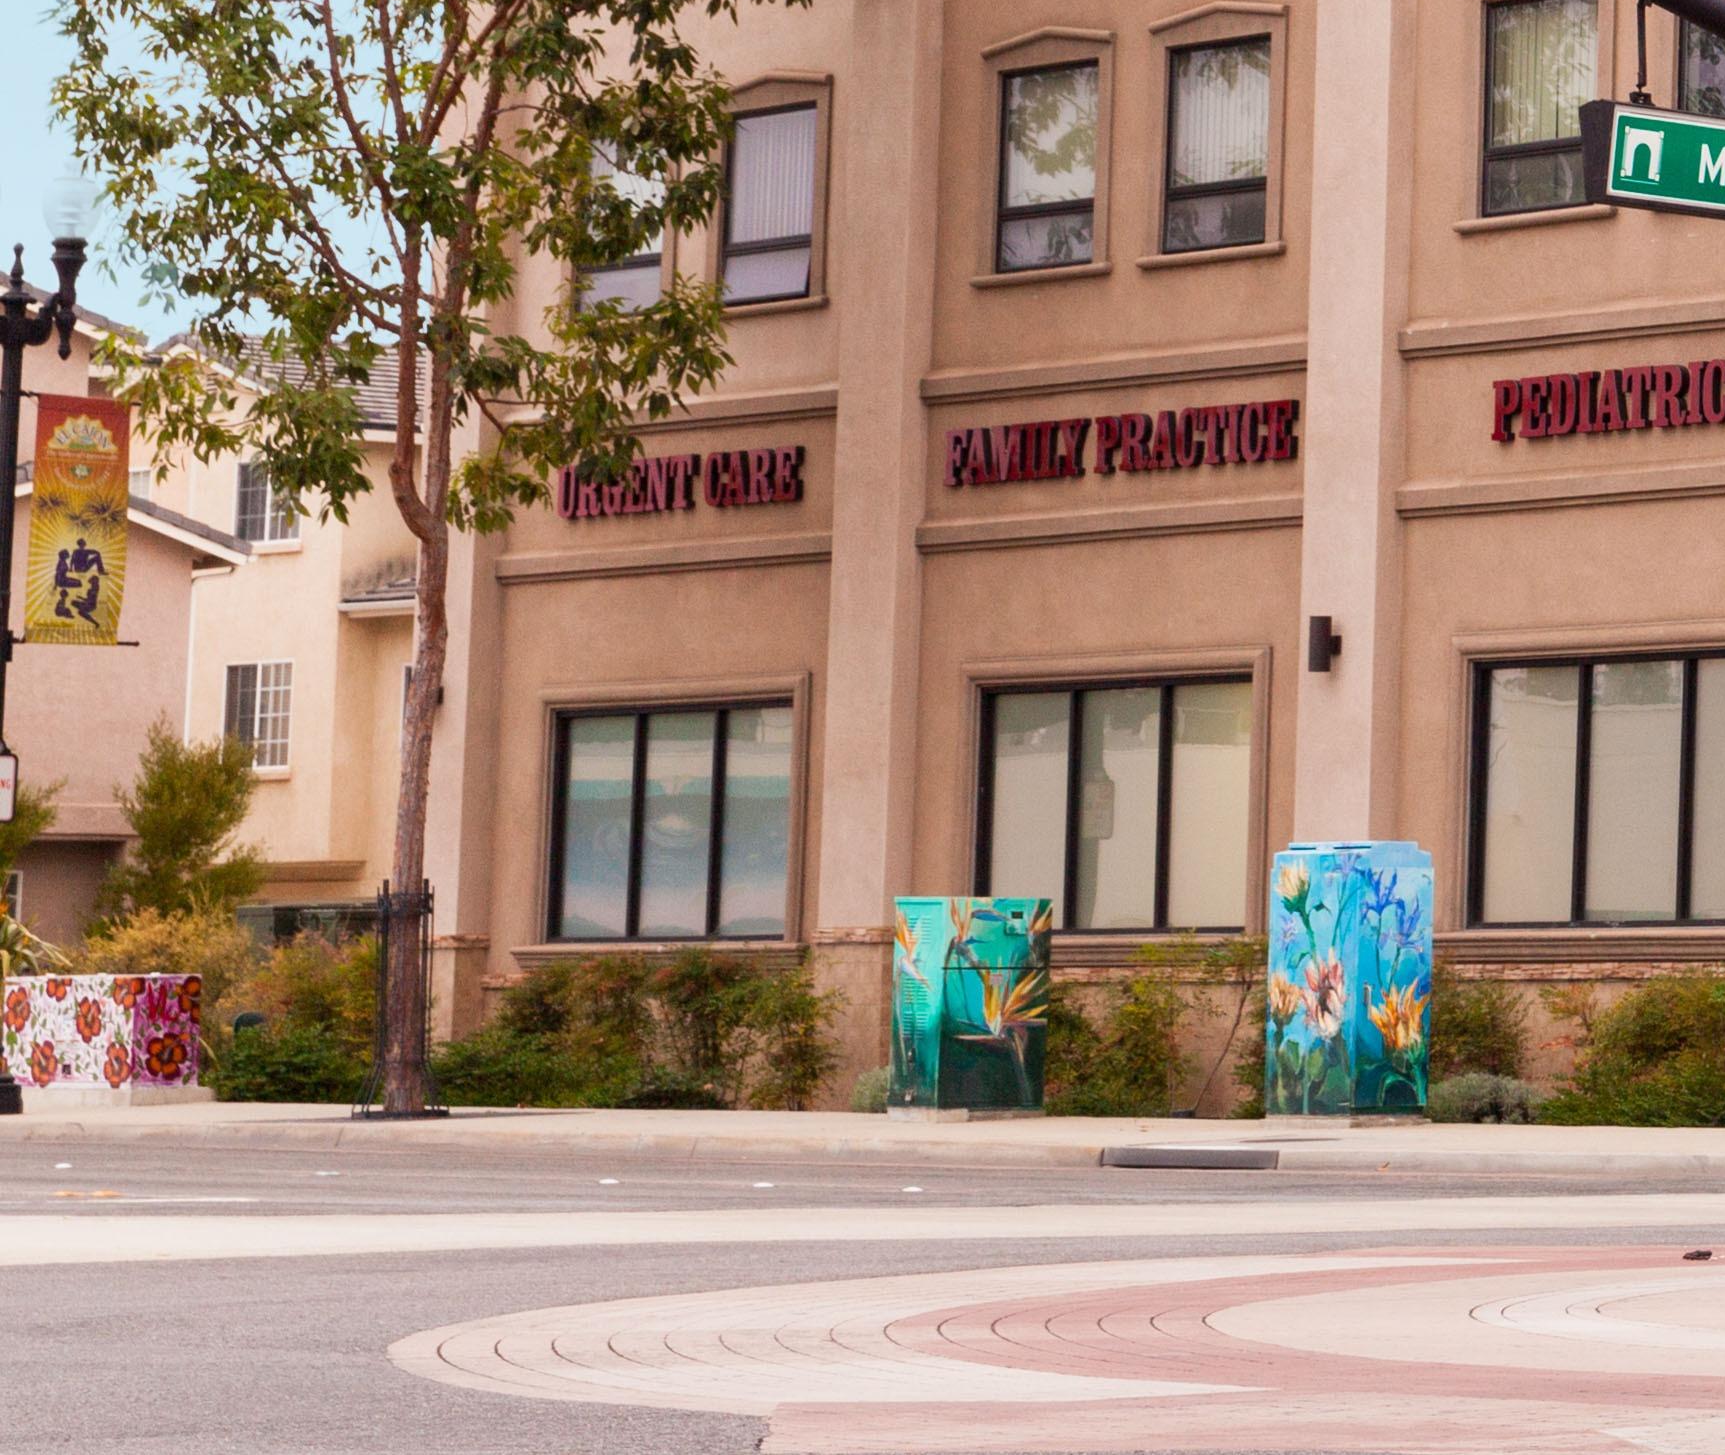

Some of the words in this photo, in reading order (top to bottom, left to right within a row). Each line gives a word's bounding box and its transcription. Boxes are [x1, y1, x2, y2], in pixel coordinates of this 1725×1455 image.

[704, 445, 805, 507] CARE
[944, 418, 1091, 487] FAMILY
[1094, 399, 1299, 474] PRACTICE
